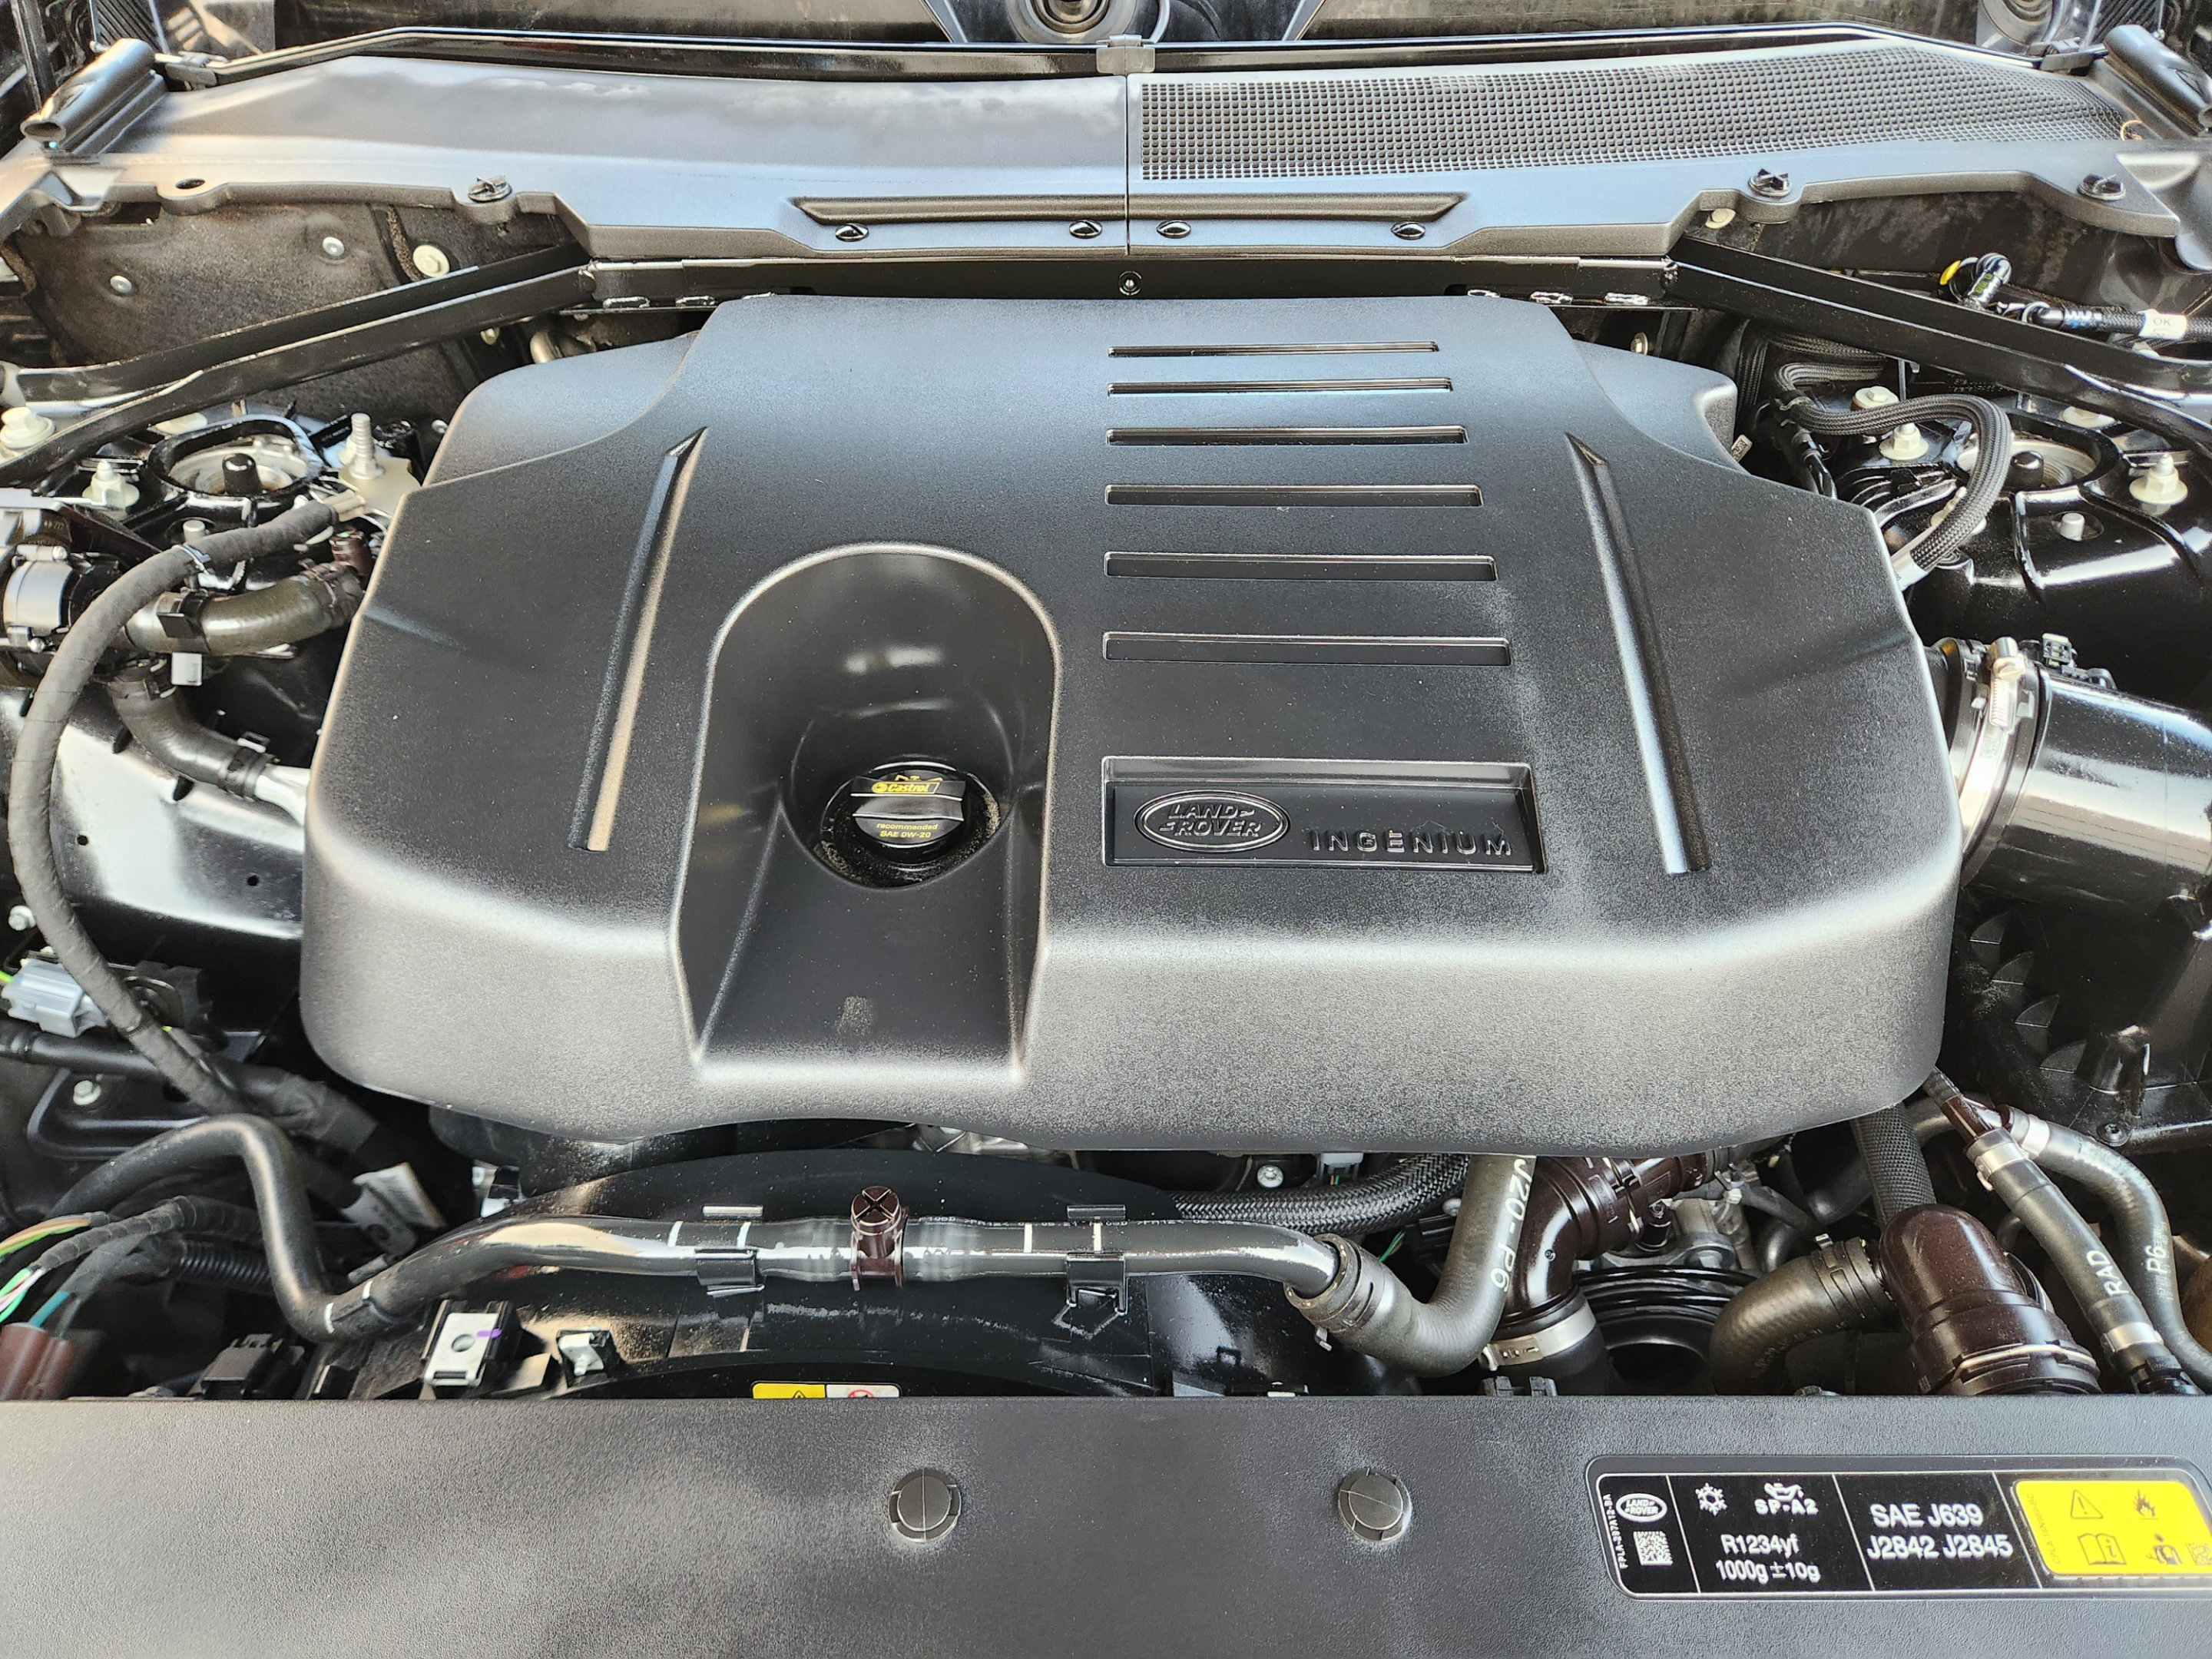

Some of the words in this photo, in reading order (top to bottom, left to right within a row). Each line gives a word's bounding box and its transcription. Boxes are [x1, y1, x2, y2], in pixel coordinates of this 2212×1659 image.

[887, 783, 930, 792] Castrol
[1167, 803, 1239, 820] LAND
[1173, 820, 1261, 836] ROVER
[1310, 830, 1512, 856] INGENIUM
[2145, 1245, 2167, 1274] P6
[2086, 1250, 2129, 1298] RAD
[1629, 1506, 1659, 1515] ROVER
[1754, 1498, 1819, 1515] SP-A2
[1869, 1503, 1925, 1528] SAE
[1927, 1503, 1984, 1528] J639
[1720, 1533, 1800, 1558] R1234yf
[1866, 1535, 1940, 1560] J2842
[1942, 1534, 2014, 1559] J2845
[1715, 1559, 1769, 1584] 1000g
